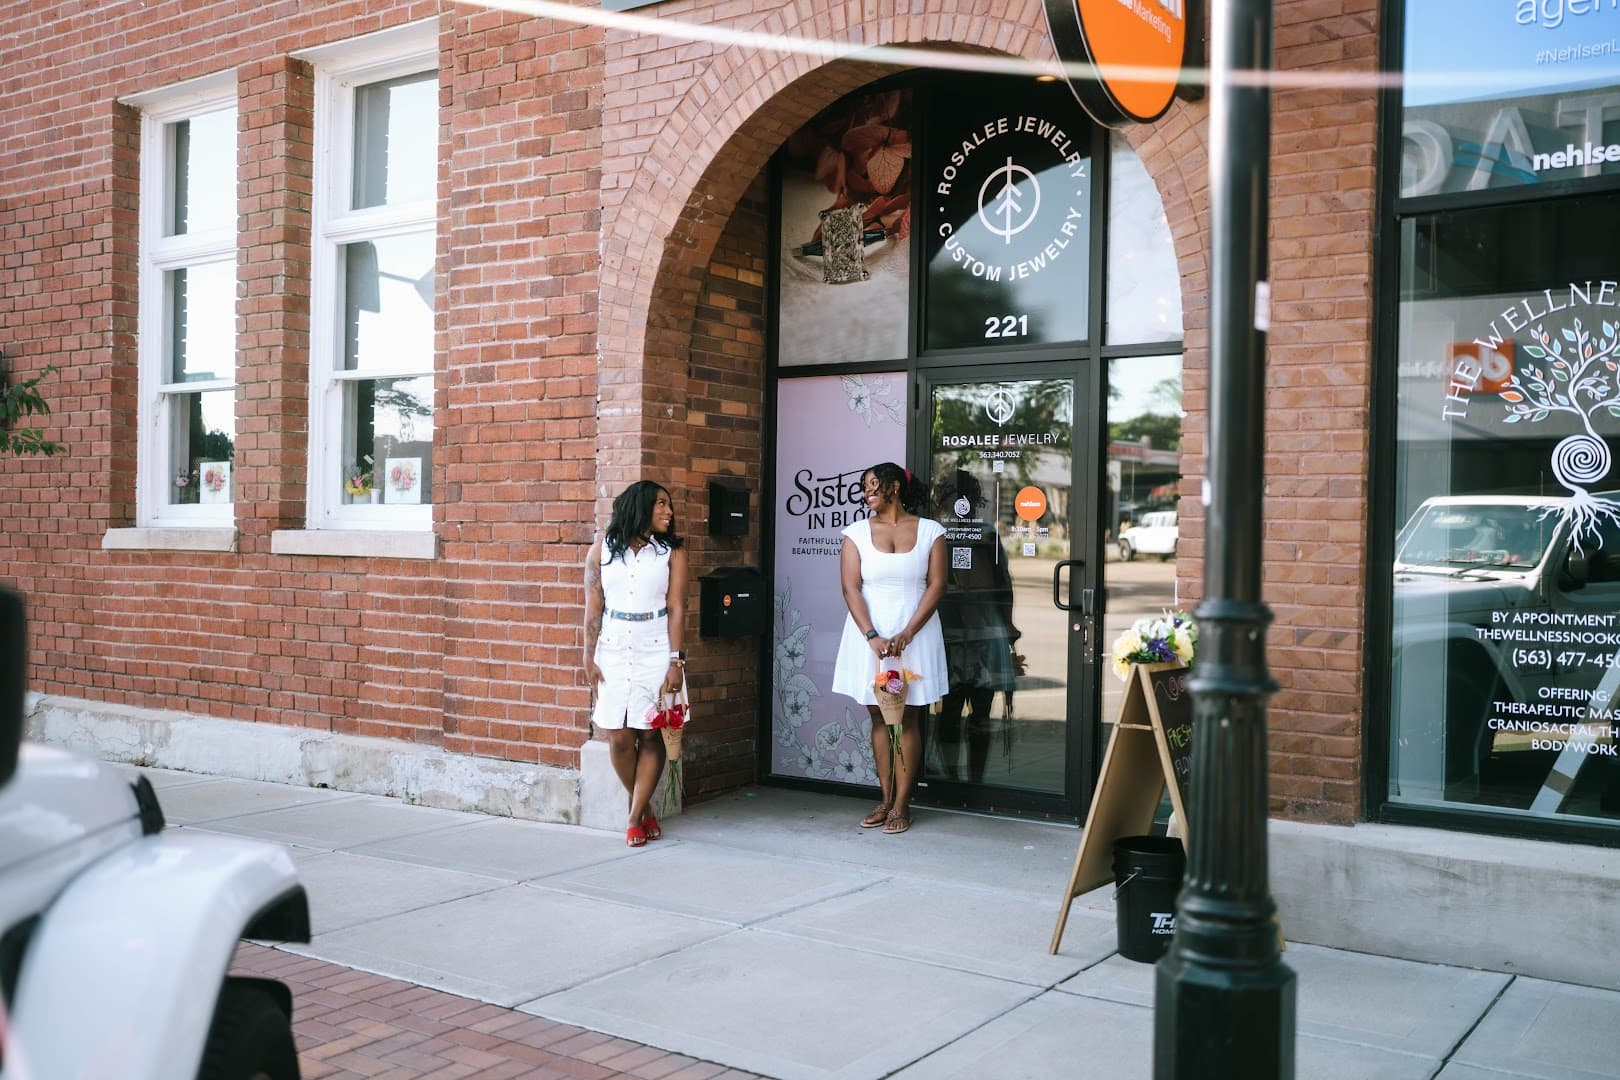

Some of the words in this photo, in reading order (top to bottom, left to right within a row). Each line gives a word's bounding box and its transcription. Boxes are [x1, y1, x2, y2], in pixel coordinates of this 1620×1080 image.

[937, 117, 1009, 195] ROSALEE
[1015, 116, 1087, 180] JEWELRY
[939, 222, 1001, 282] CUSTOM
[1008, 206, 1083, 281] JEWELRY
[985, 315, 1028, 338] 221
[1441, 361, 1482, 421] THE
[1472, 280, 1620, 351] WELLNE
[942, 434, 1000, 446] ROSALEE
[1002, 433, 1060, 445] JEWELRY
[979, 451, 1020, 459] 563.340.7052
[786, 469, 866, 517] Siste
[808, 512, 826, 530] IN
[831, 507, 872, 528] BLO
[1492, 611, 1509, 624] BY
[1512, 612, 1616, 627] APPOINTMENT
[1512, 648, 1552, 669] (563)
[1538, 686, 1611, 702] OFFERING:
[1493, 701, 1586, 718] THERAPEUTIC
[1487, 718, 1596, 737] CRANIOSACRAL
[1531, 739, 1617, 756] BODYWORK
